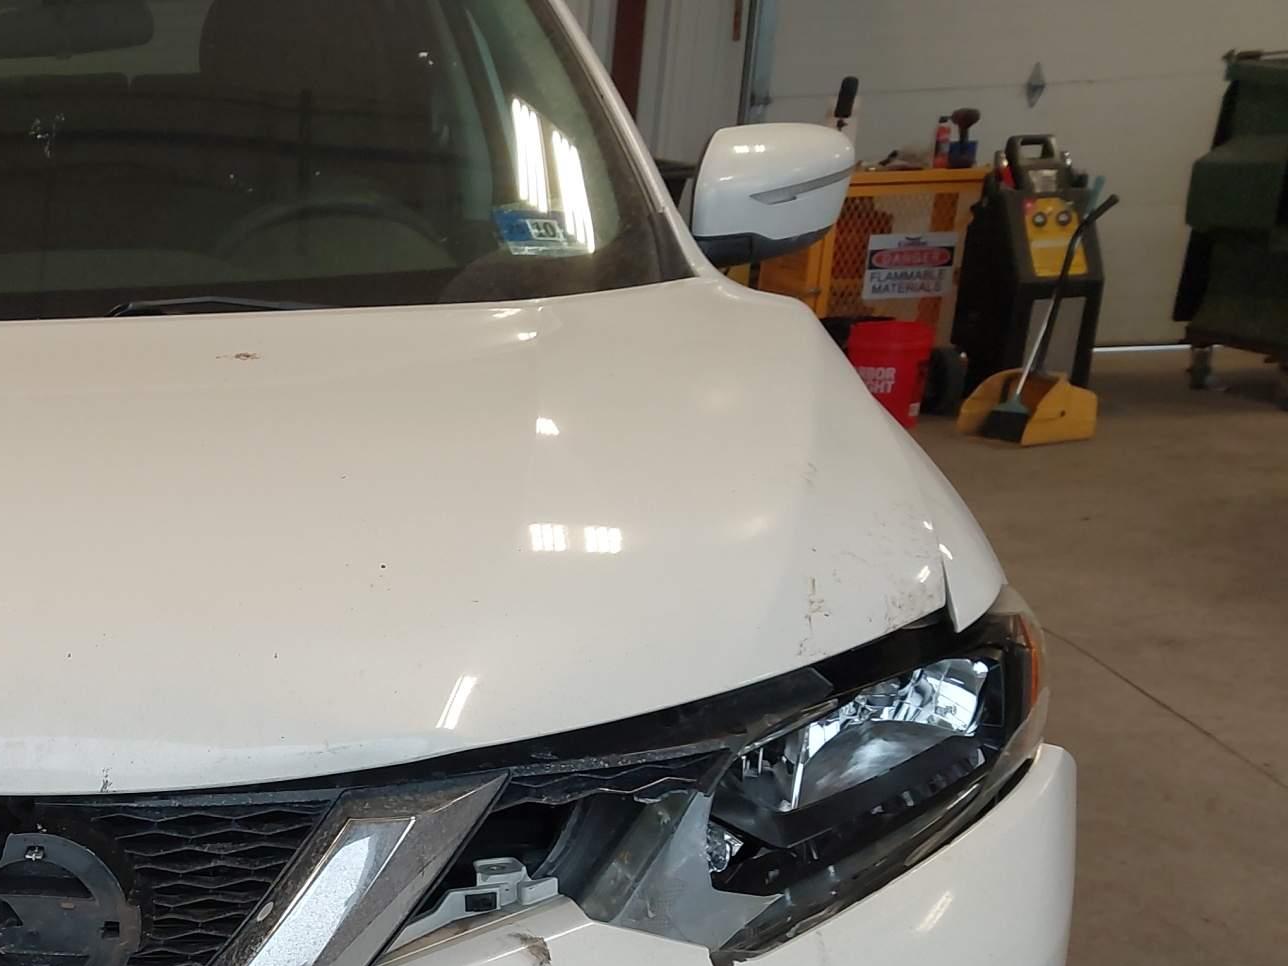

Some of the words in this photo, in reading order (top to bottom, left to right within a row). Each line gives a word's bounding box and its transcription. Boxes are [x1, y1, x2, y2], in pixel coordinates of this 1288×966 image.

[880, 250, 943, 266] DANGER
[870, 269, 945, 282] FLAMMABLE
[871, 281, 943, 295] MATERIALS
